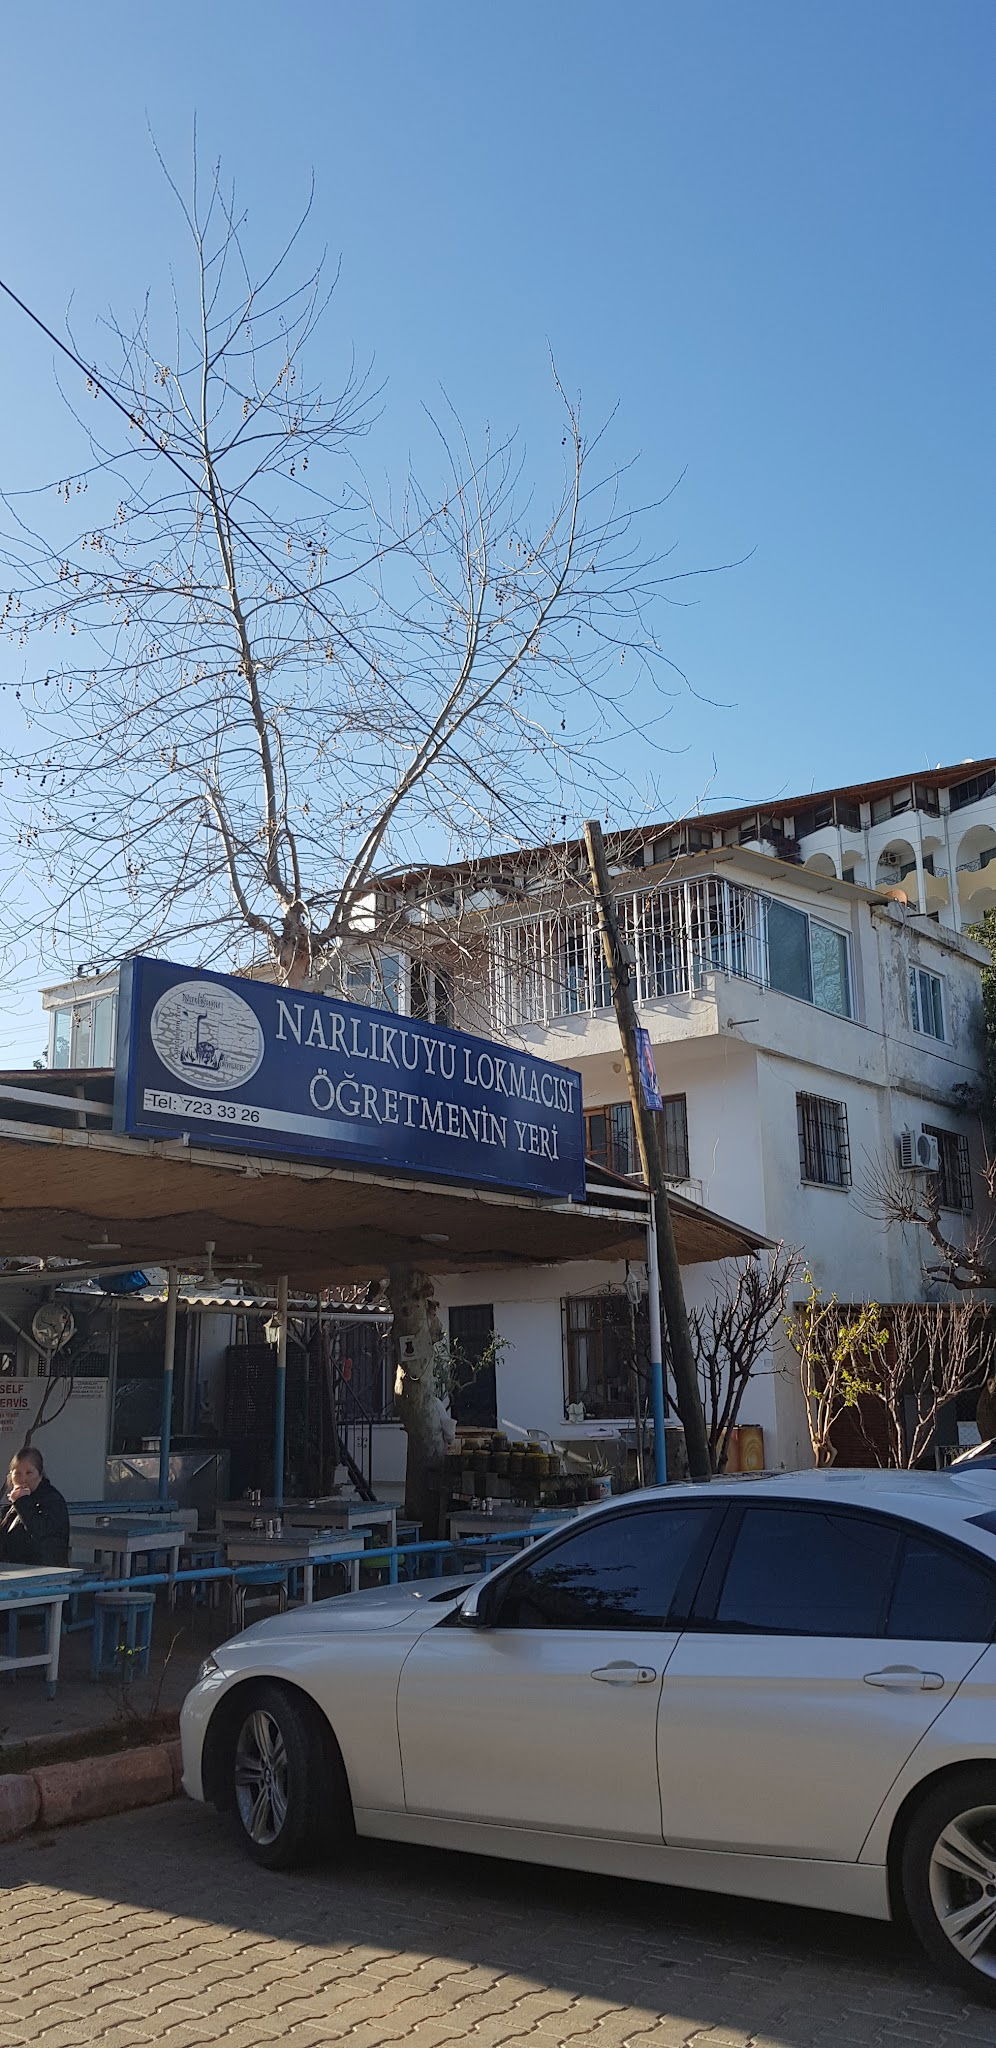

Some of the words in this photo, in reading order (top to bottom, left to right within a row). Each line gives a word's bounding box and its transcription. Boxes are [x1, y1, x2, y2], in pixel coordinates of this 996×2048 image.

[276, 999, 457, 1080] NARLIKUYU
[463, 1048, 575, 1115] LOKMACISI
[150, 1093, 177, 1110] Tel:
[183, 1098, 212, 1116] 723
[217, 1104, 236, 1119] 33
[241, 1109, 260, 1123] 26
[309, 1067, 508, 1149] ÖĞRETMENİN
[514, 1119, 559, 1162] YERİ
[0, 1384, 24, 1394] SELF
[0, 1396, 28, 1408] ERVİS
